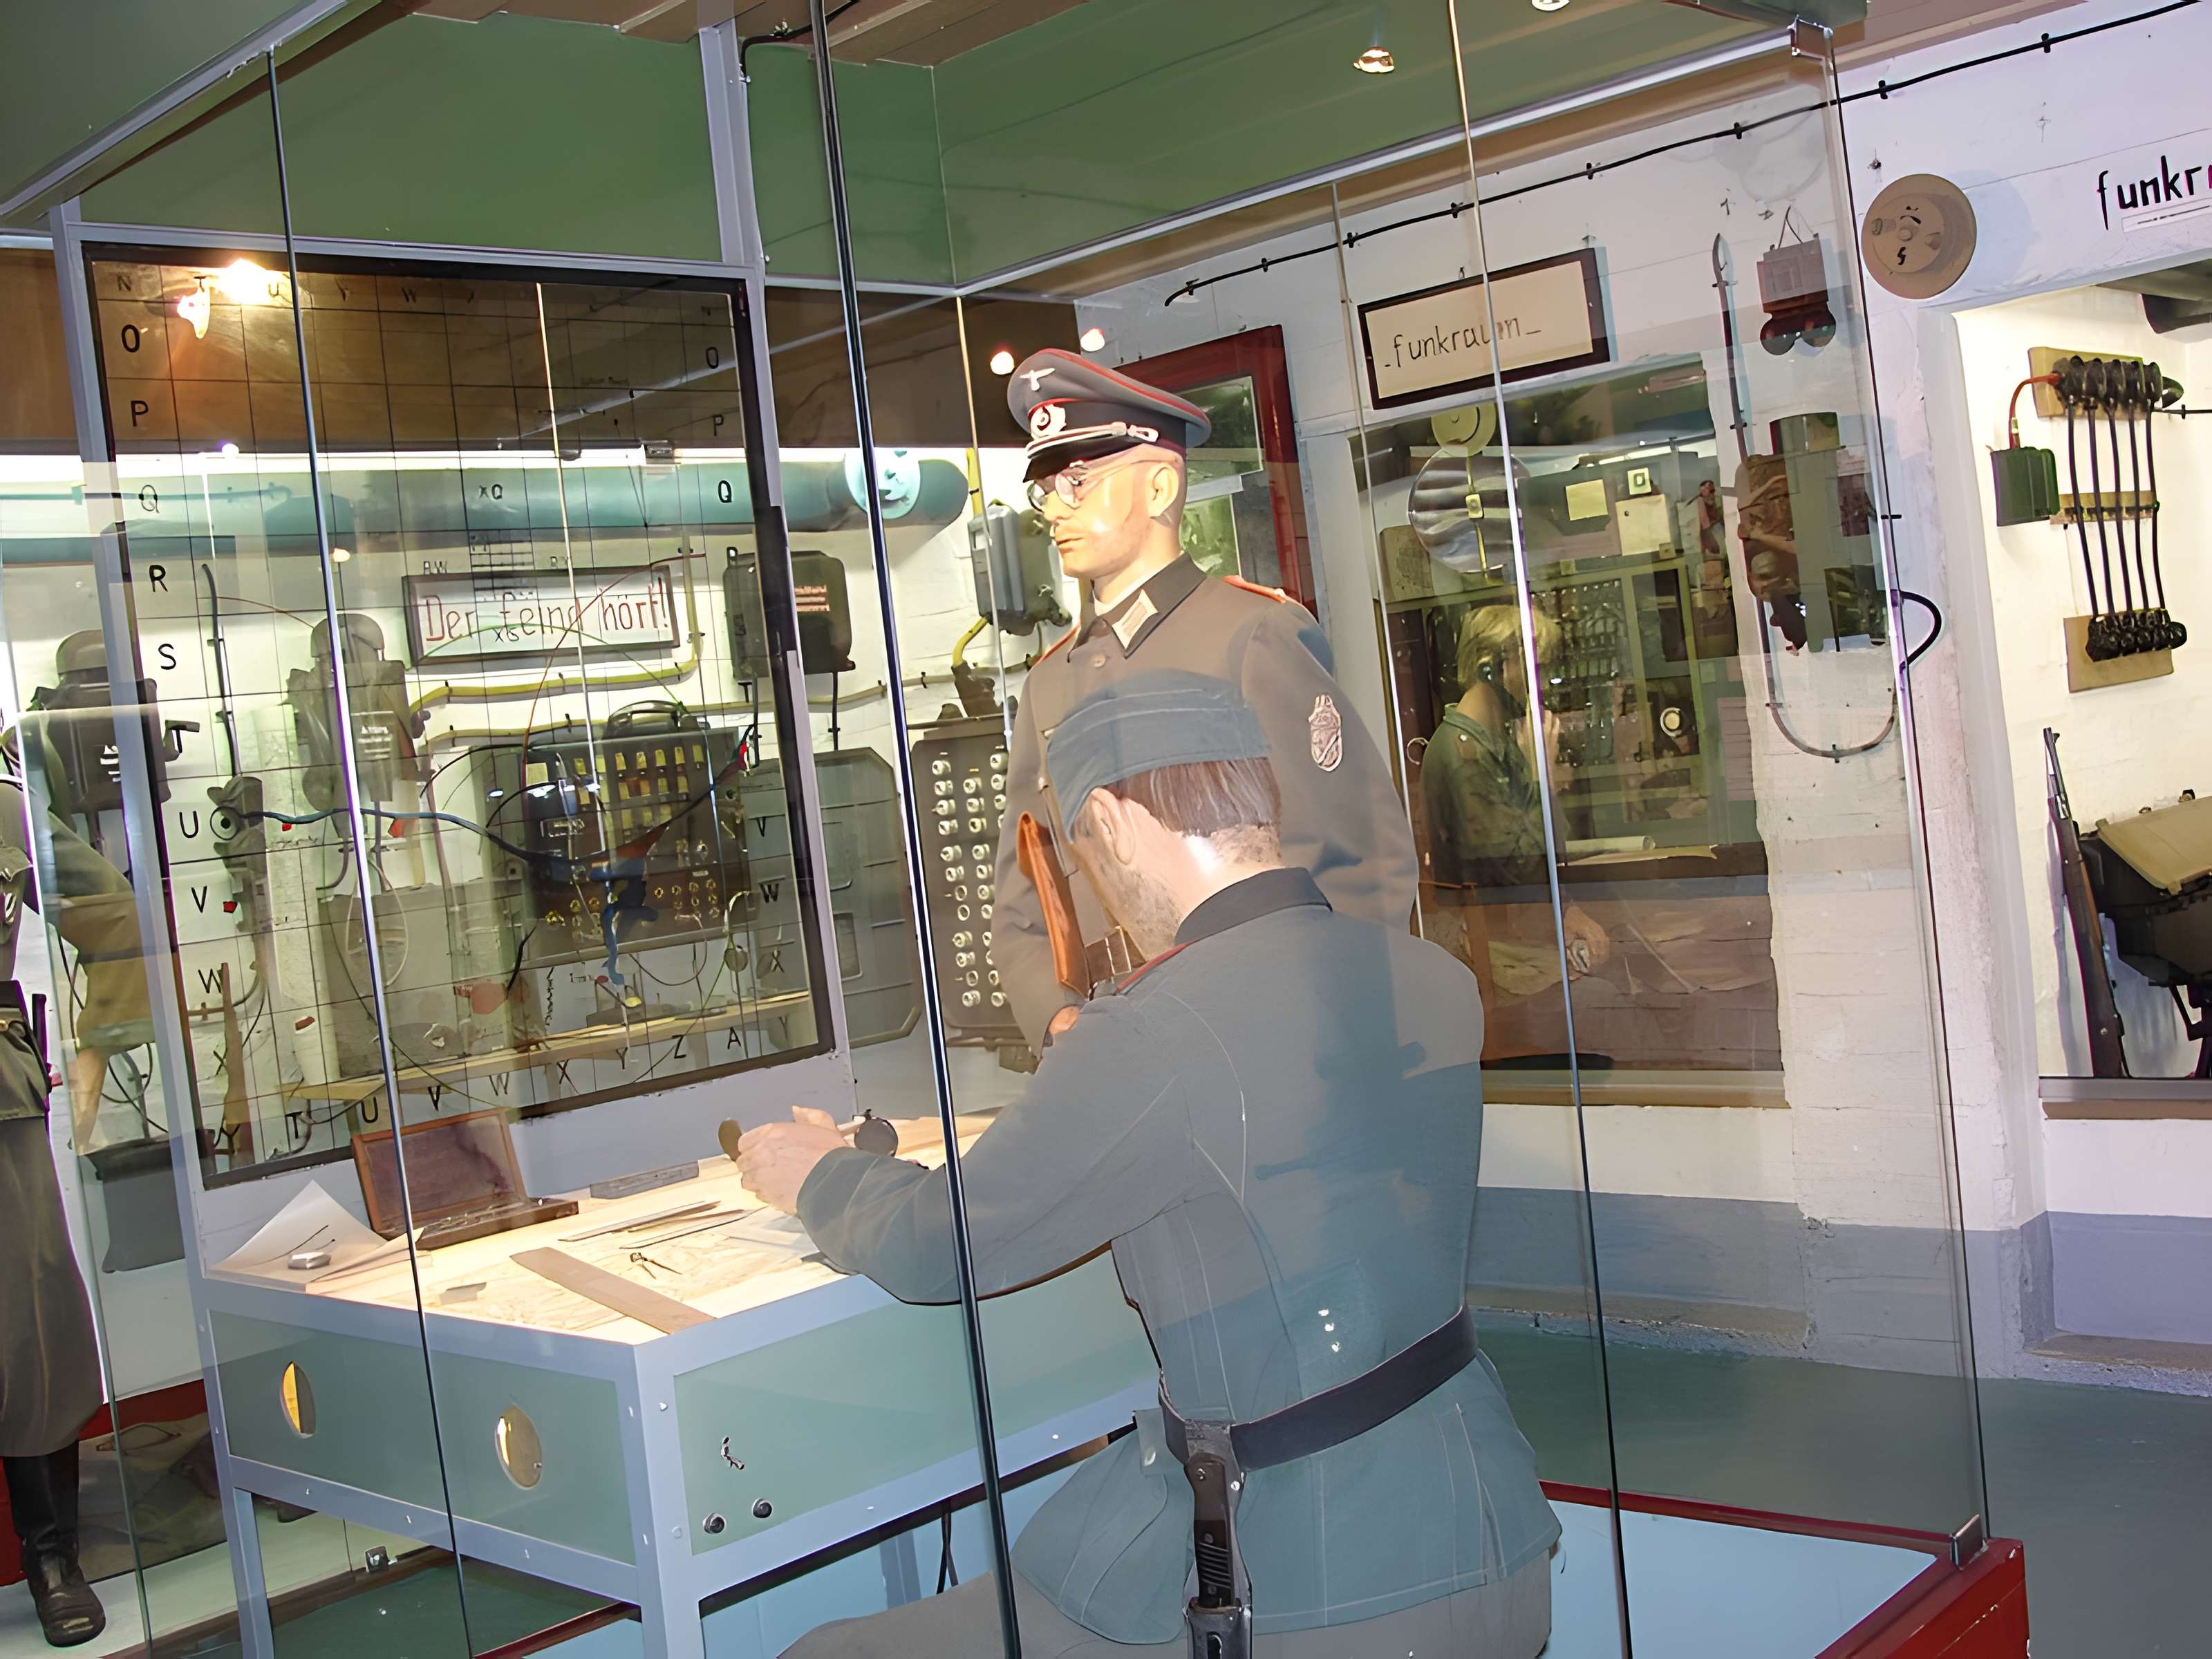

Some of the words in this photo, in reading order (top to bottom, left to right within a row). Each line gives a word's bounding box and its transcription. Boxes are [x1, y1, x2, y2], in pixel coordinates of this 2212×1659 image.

[2097, 155, 2212, 231] funkr
[130, 400, 149, 427] P
[149, 564, 168, 592] R
[424, 595, 479, 641] Der
[158, 643, 177, 671] S
[179, 810, 199, 838] U
[191, 885, 208, 913] V
[360, 1096, 379, 1124] U
[427, 1085, 441, 1112] V
[671, 1035, 686, 1059] Z
[727, 1027, 742, 1050] A
